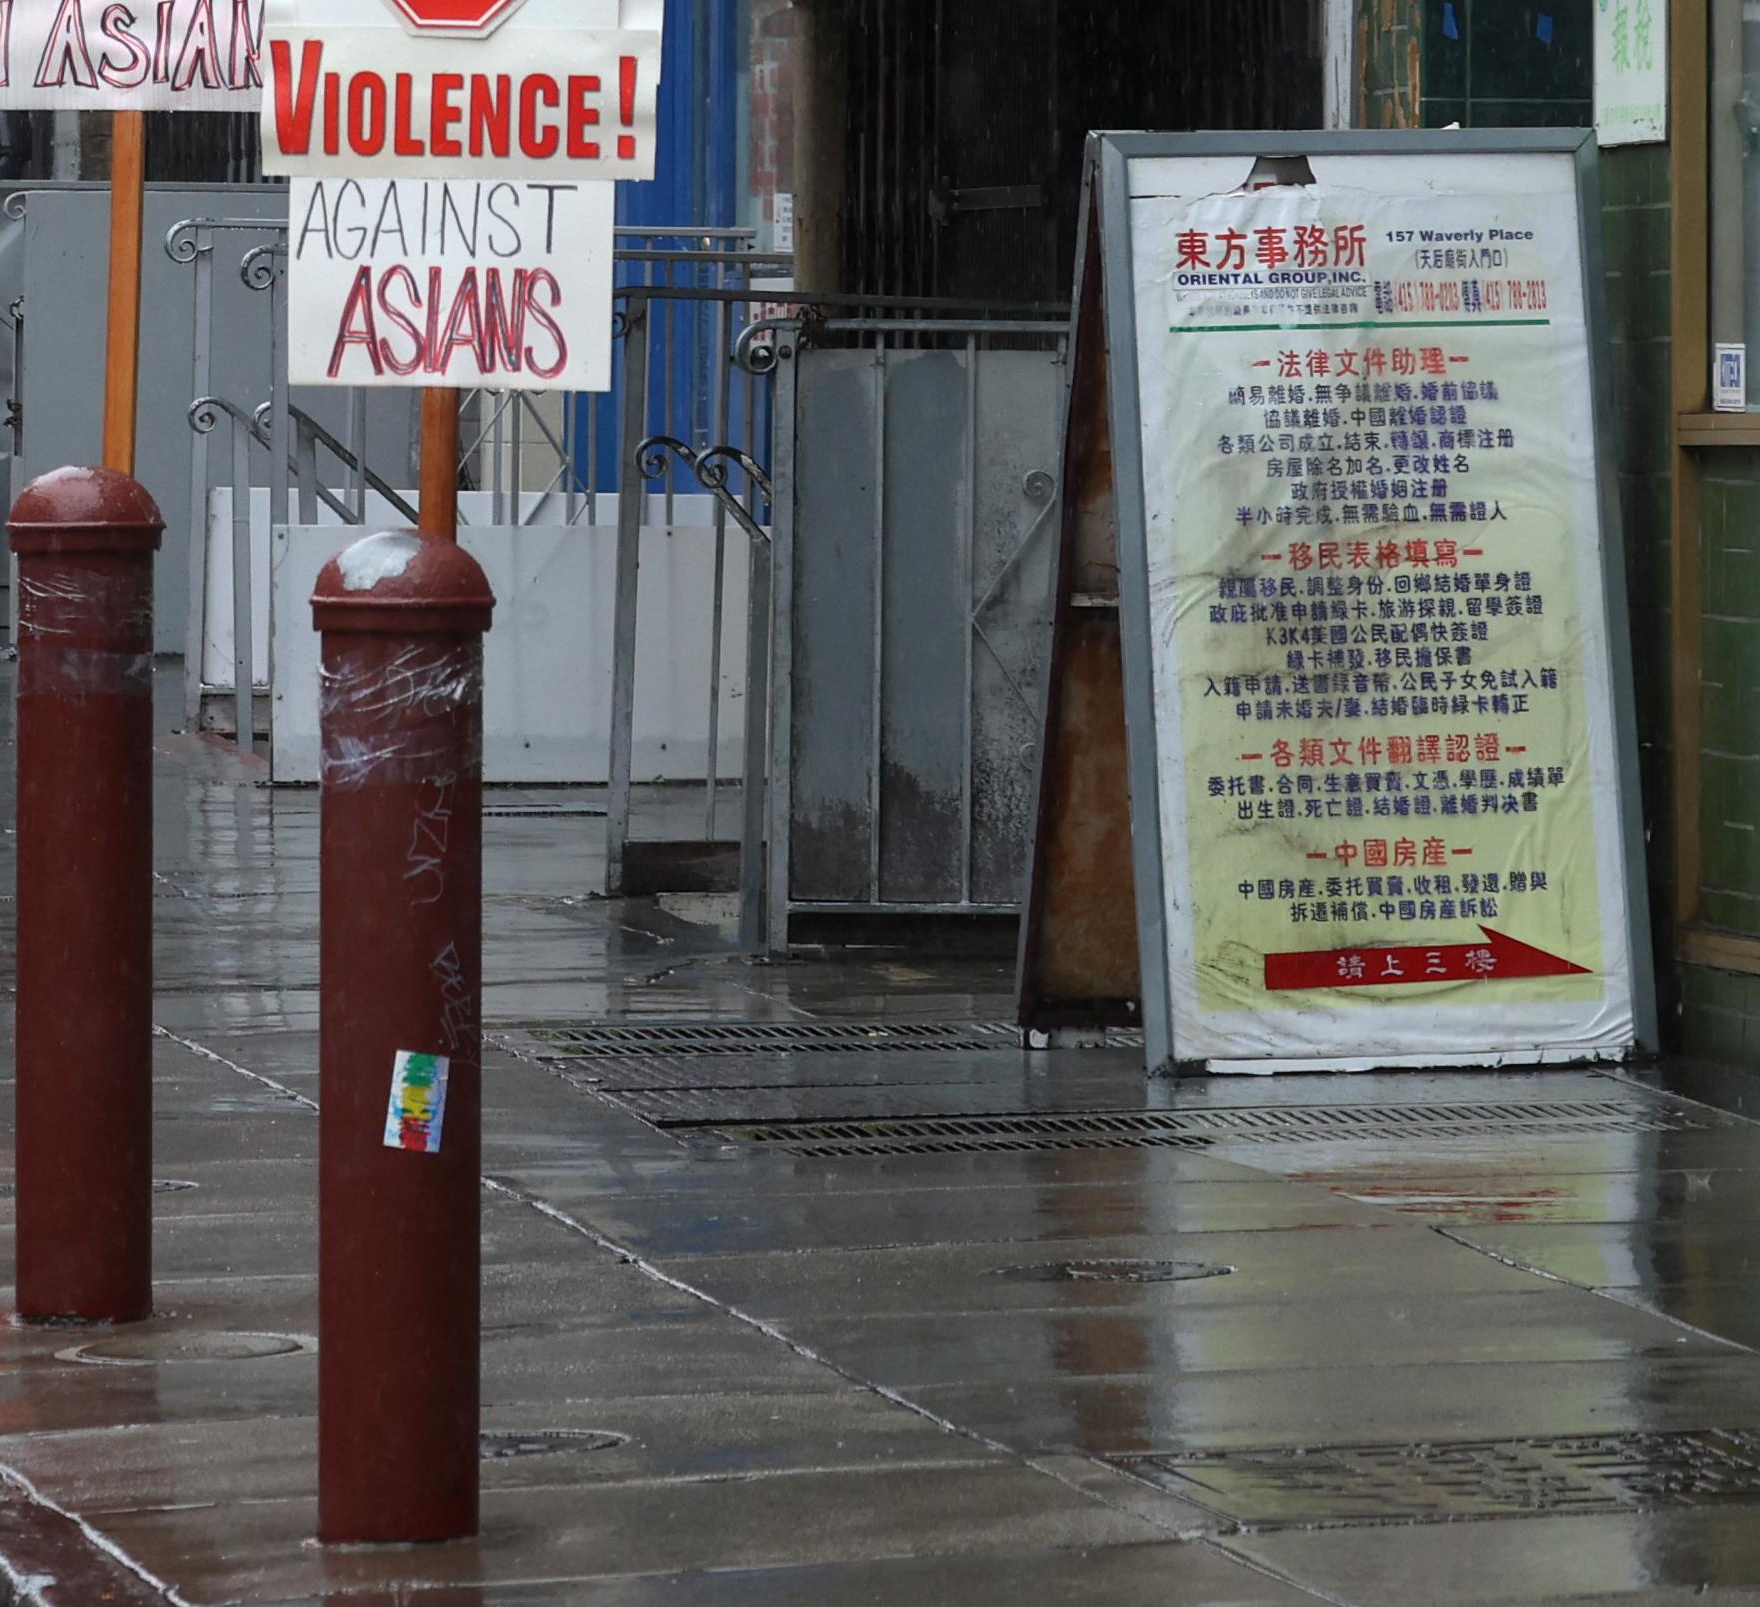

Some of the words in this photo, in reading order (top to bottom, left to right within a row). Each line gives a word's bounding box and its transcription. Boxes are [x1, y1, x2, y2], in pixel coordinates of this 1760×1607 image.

[296, 183, 578, 261] AGAINST
[1386, 231, 1415, 243] 157
[1419, 230, 1483, 243] Waverly
[1489, 228, 1535, 241] Place
[1174, 223, 1368, 271] 東方事務所
[1178, 273, 1264, 286] ORIENTAL
[327, 264, 567, 379] ASIANS
